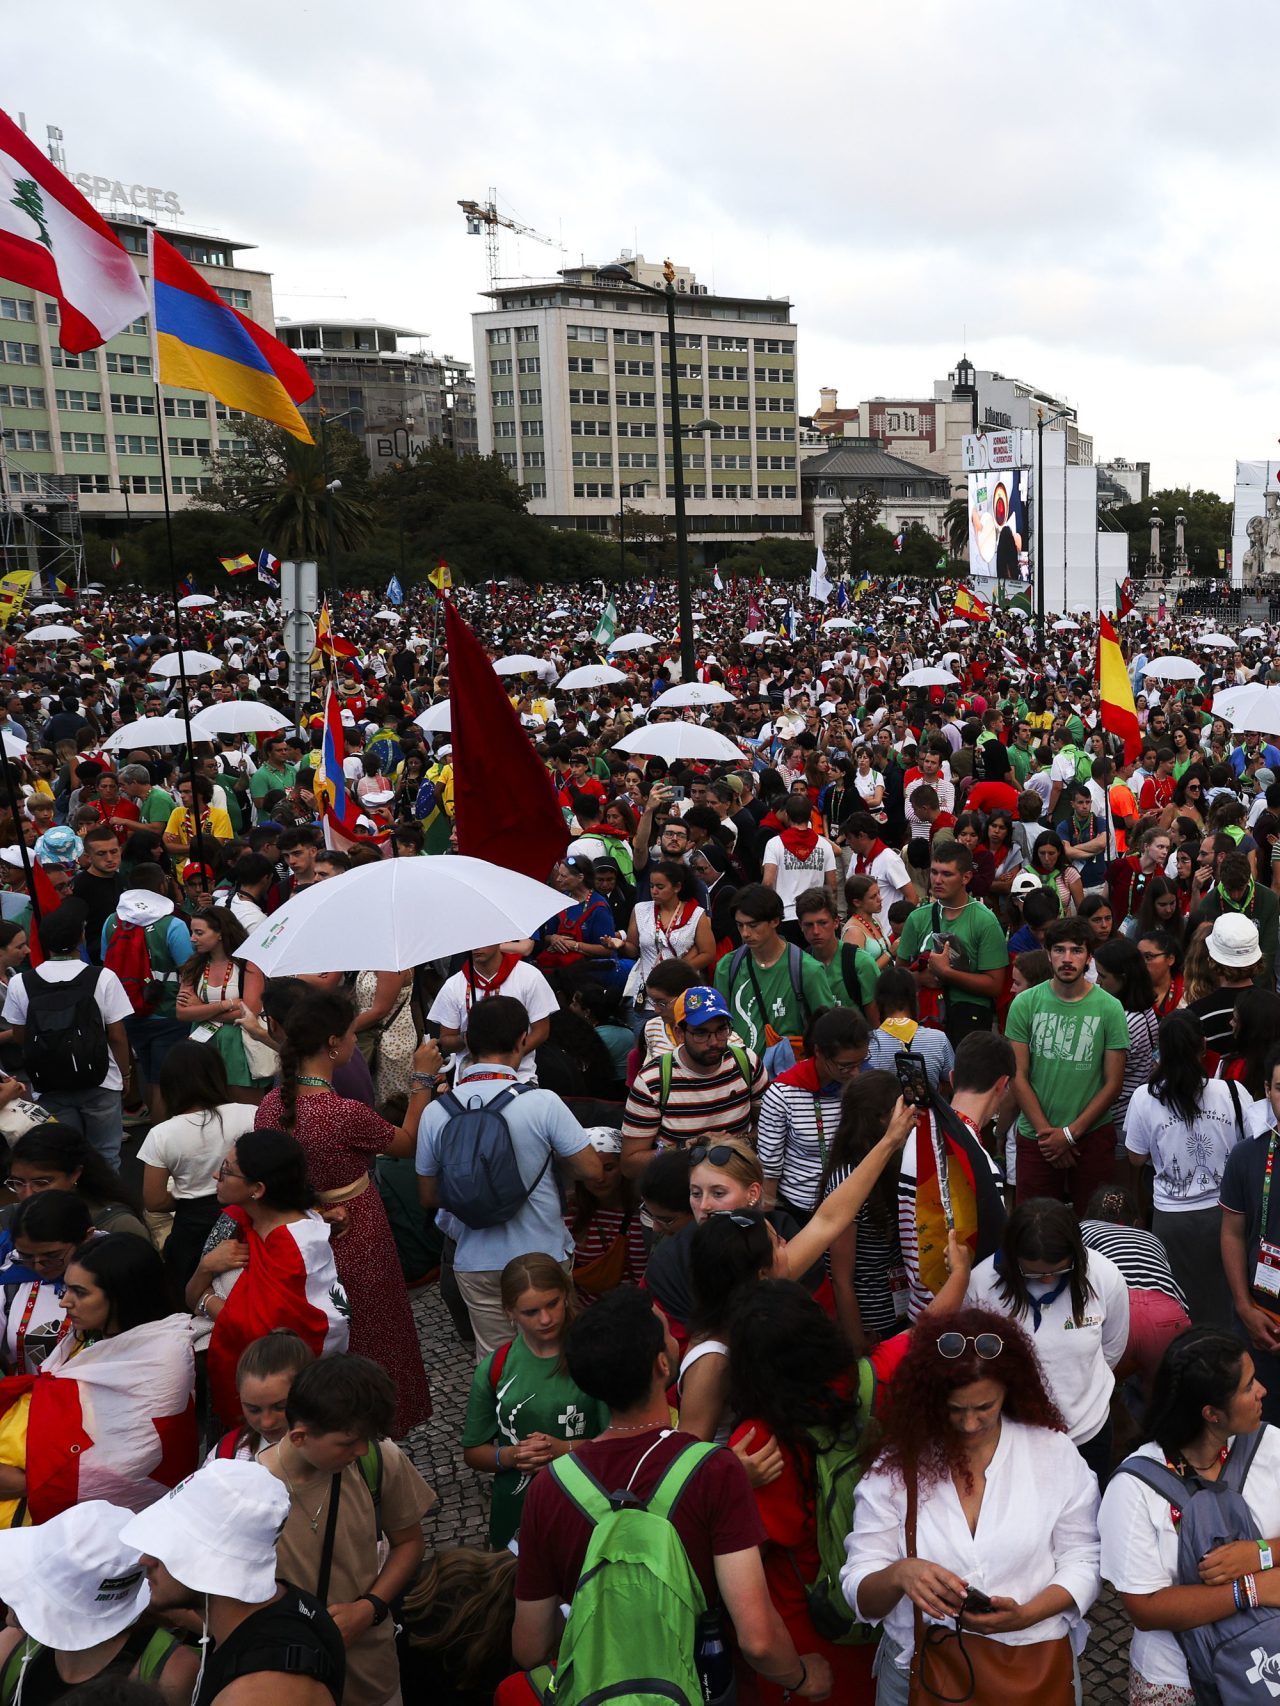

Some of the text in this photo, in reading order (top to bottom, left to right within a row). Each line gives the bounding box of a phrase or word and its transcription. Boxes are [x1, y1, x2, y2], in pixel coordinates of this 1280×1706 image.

[76, 172, 184, 215] SPACES.
[377, 428, 425, 459] BOW
[993, 446, 1008, 455] MUNDIAL
[1029, 1012, 1101, 1062] HULK
